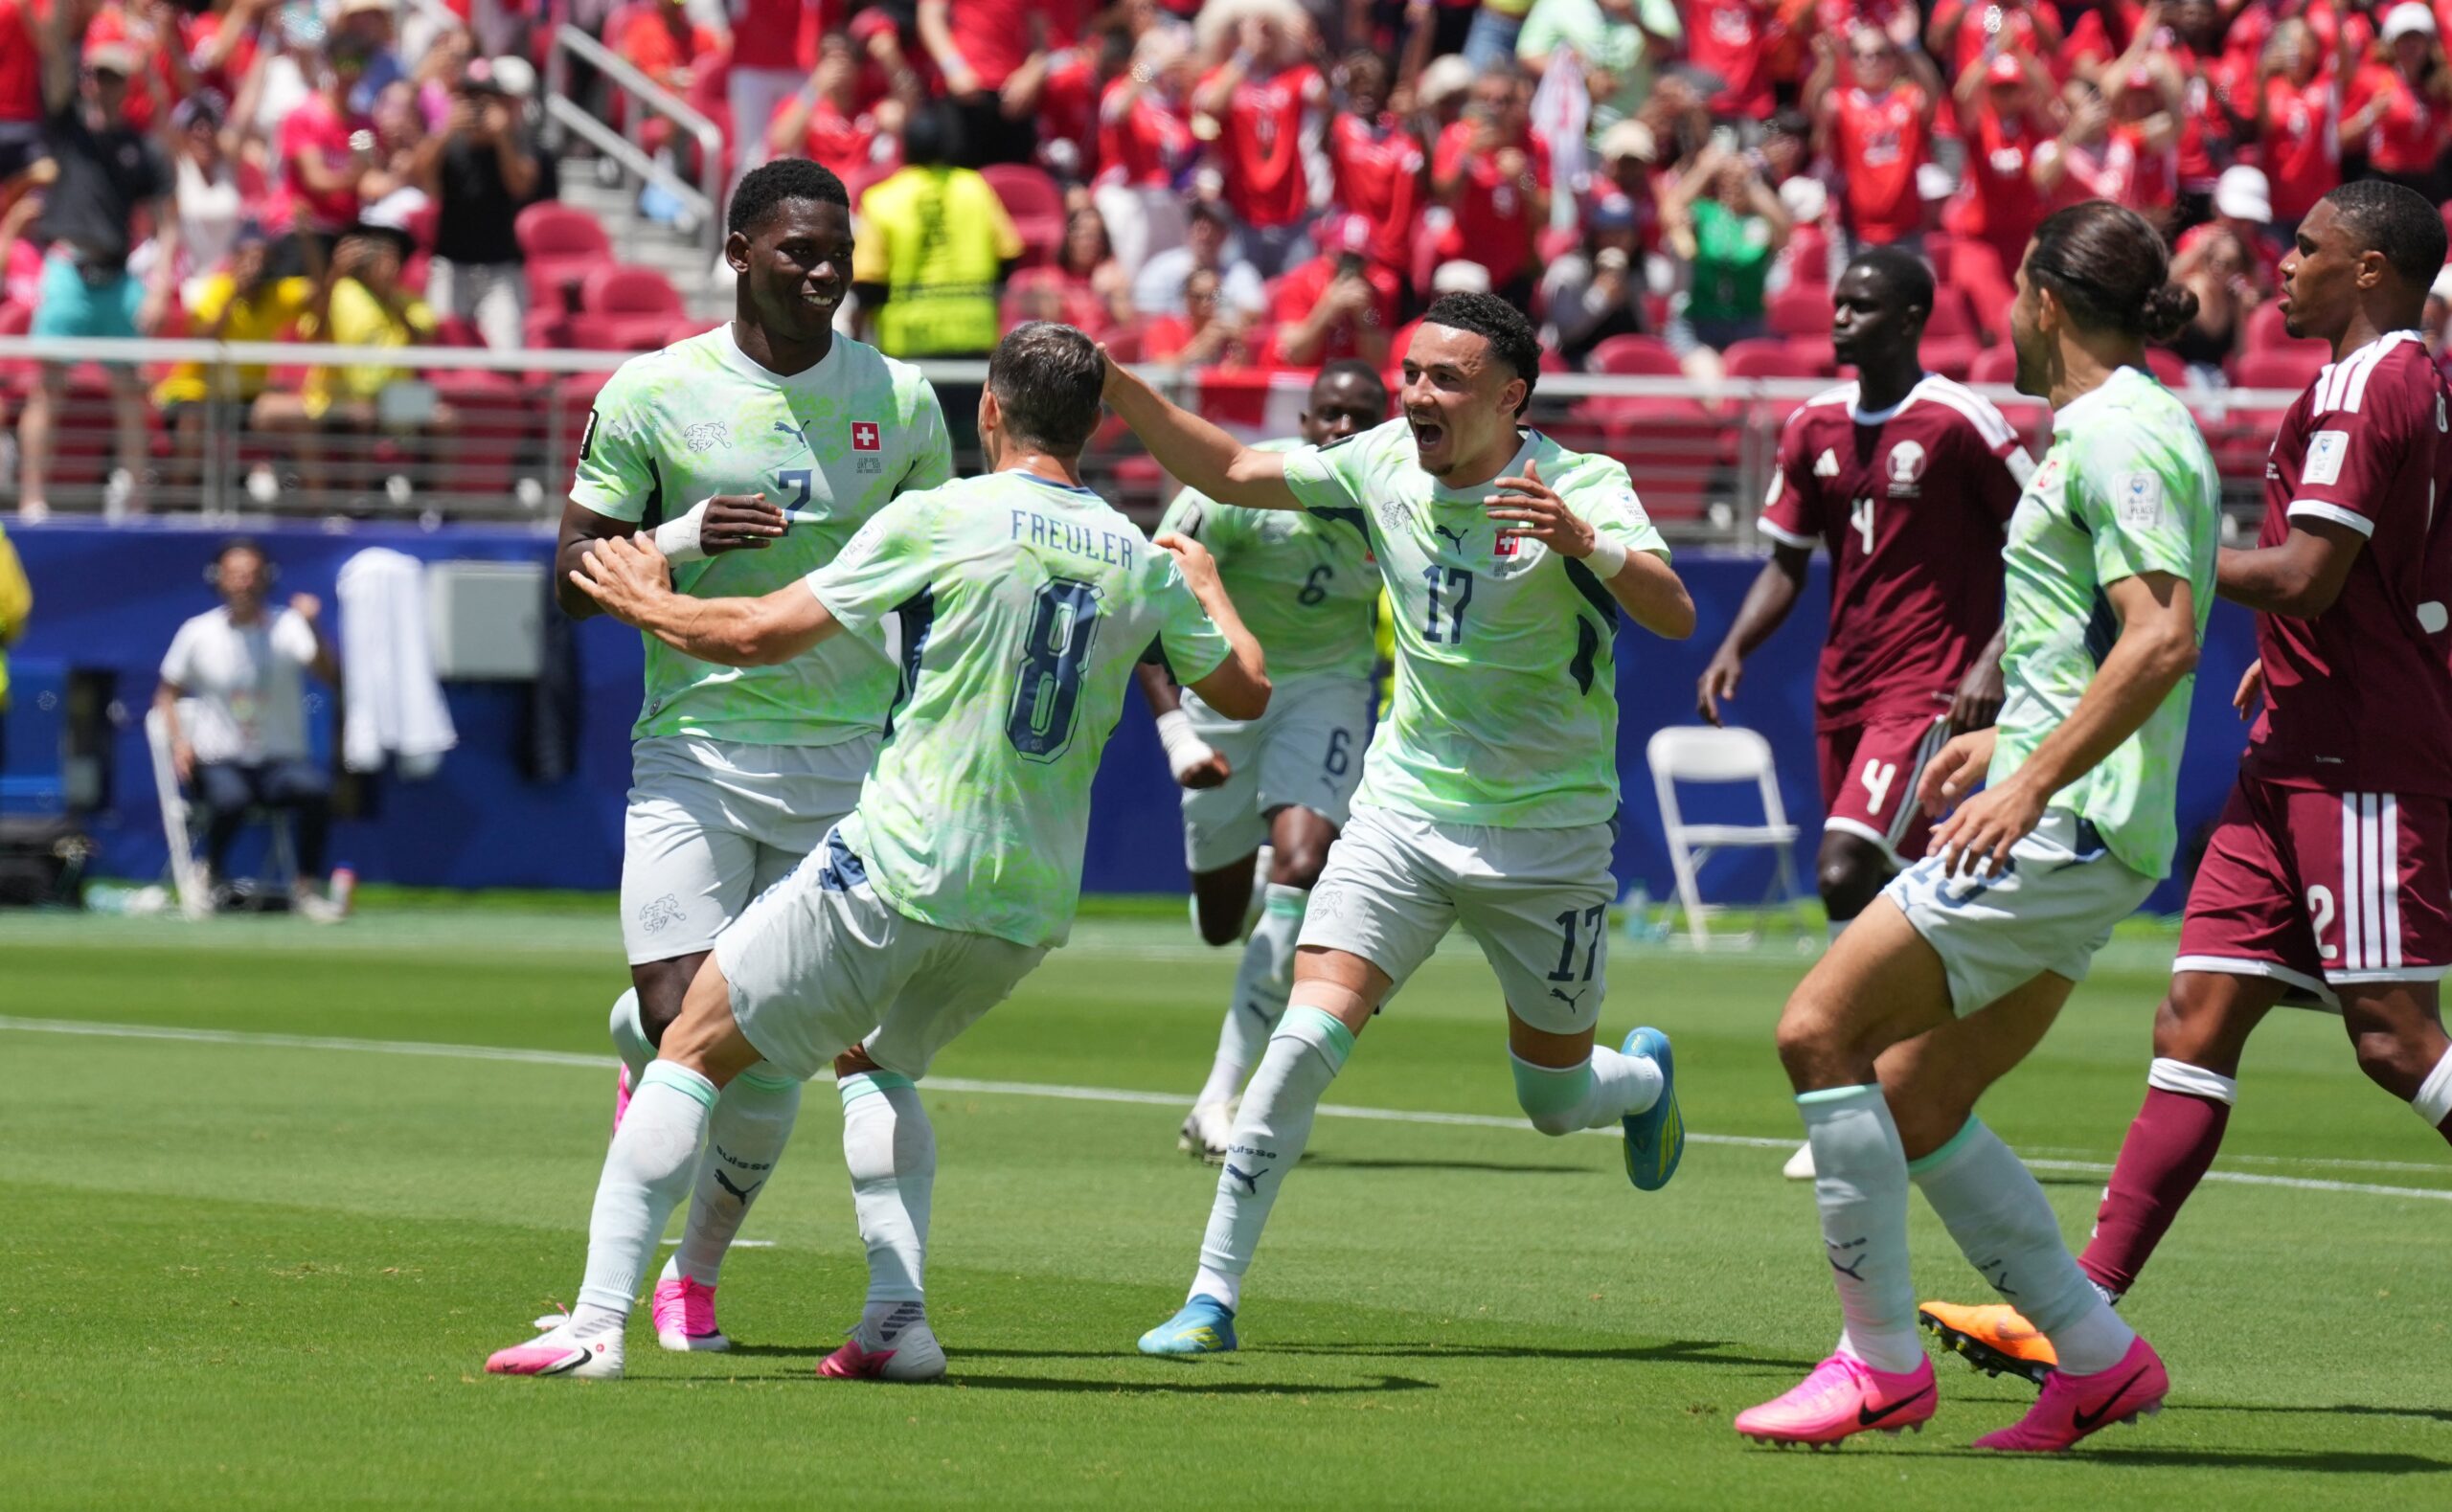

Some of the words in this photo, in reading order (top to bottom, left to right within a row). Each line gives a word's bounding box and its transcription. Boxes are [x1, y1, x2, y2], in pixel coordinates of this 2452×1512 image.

[778, 469, 812, 536] 7
[1850, 497, 1874, 554] 4
[1011, 509, 1133, 571] FREULER
[1297, 564, 1333, 607] 6
[1422, 564, 1473, 644] 17
[1005, 575, 1105, 764] 8
[1325, 727, 1351, 777] 6
[1861, 757, 1897, 817] 4
[1547, 903, 1606, 982] 17
[2306, 884, 2338, 959] 2
